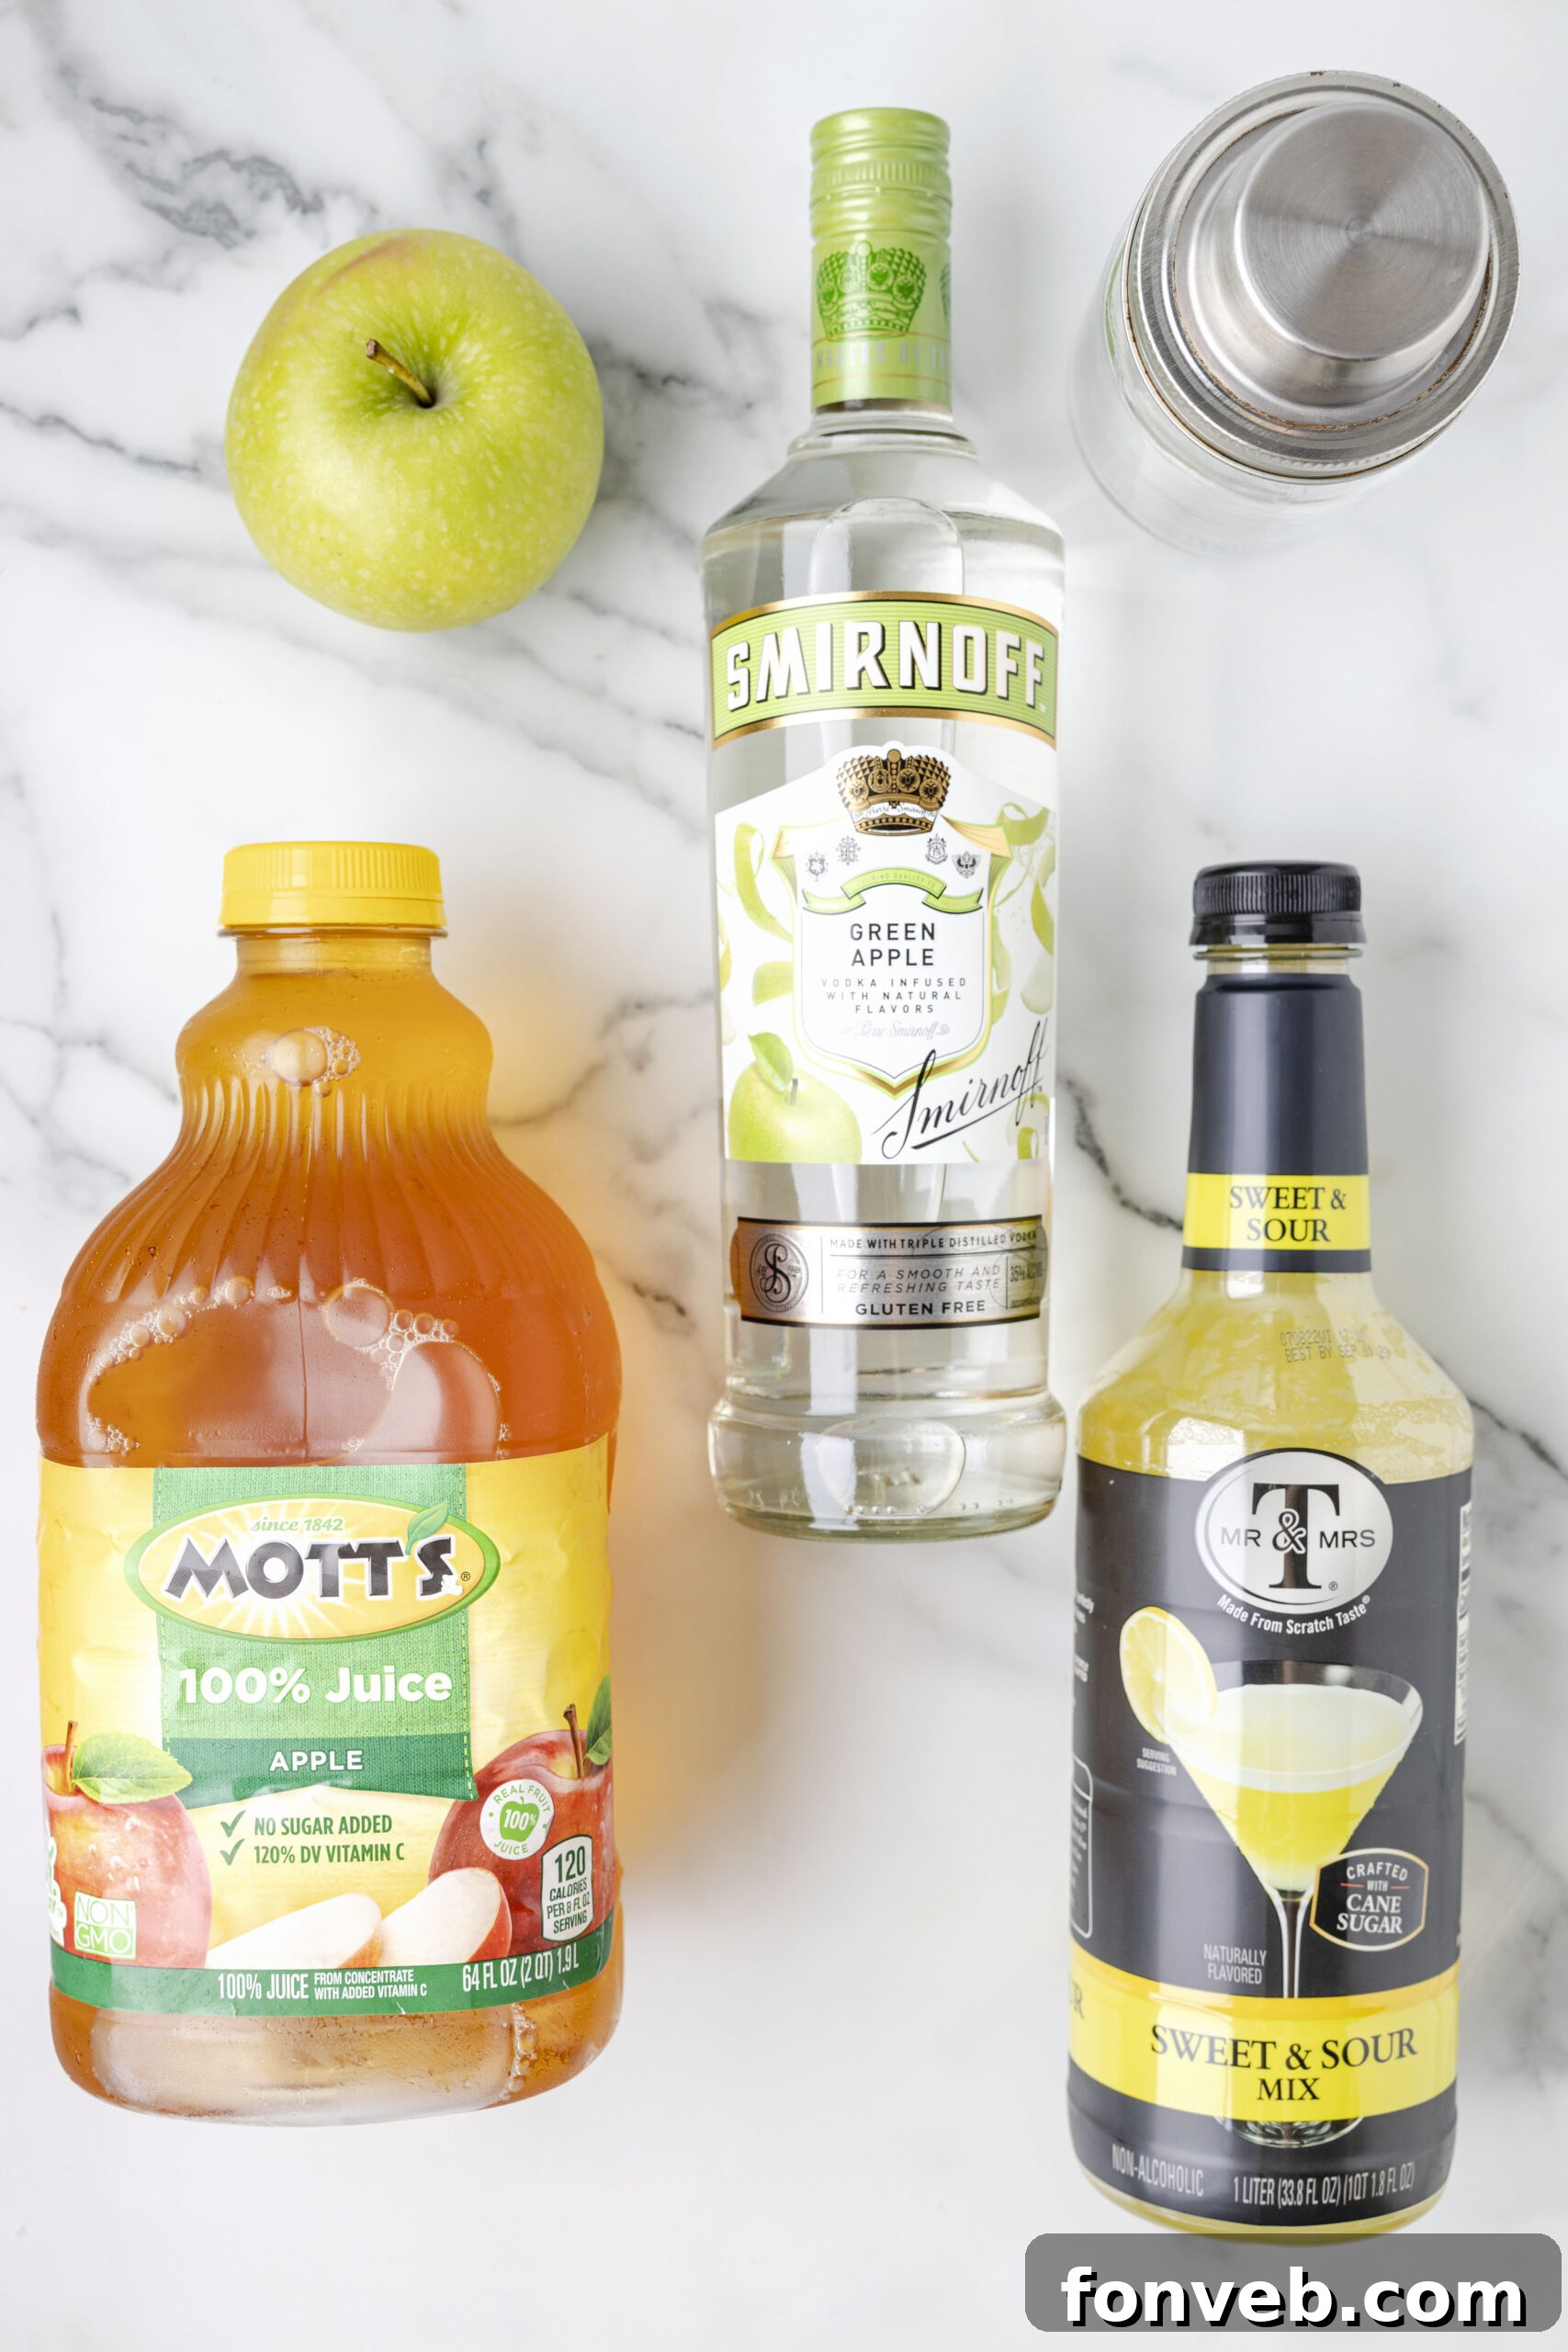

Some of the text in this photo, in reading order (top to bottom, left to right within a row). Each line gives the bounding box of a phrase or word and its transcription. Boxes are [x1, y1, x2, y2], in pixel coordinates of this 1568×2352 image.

[726, 620, 1044, 711] SMIRNOFF
[850, 922, 936, 941] GREEN
[851, 948, 934, 967] APPLE
[821, 978, 966, 987] VODKA INFUSED
[827, 991, 962, 1001] WITH NATURAL
[855, 1005, 934, 1013] FLAVORS
[871, 1017, 1049, 1159] Smirnoff
[1230, 1185, 1347, 1210] SWEET &
[1247, 1218, 1331, 1242] SOUR
[830, 1239, 863, 1249] MADE
[866, 1238, 897, 1249] WITH
[900, 1238, 944, 1249] TRIPLE
[949, 1234, 1006, 1248] DISTILLED
[837, 1265, 1000, 1280] FOR A SMOOTH AND
[837, 1278, 1000, 1294] REFRESHING TASTE
[855, 1300, 986, 1316] GLUTEN FREE
[1285, 1346, 1313, 1363] BEST
[1318, 1345, 1332, 1360] BY
[251, 1517, 344, 1532] since 1842
[1221, 1510, 1376, 1554] MR & MRS
[1252, 1483, 1340, 1589] T
[1217, 1594, 1248, 1623] Made
[1250, 1612, 1282, 1634] From
[1286, 1617, 1335, 1634] Scratch
[179, 1665, 453, 1704] 100% Juice
[269, 1750, 363, 1772] APPLE
[1142, 1747, 1170, 1763] SERVING
[1136, 1758, 1177, 1776] SUGGESTION
[493, 1784, 551, 1814] REAL FRUIT
[254, 1815, 392, 1836] NO SUGAR ADDED
[503, 1808, 537, 1831] 100%
[254, 1843, 405, 1864] 120% DV VITAMIN C
[493, 1840, 529, 1856] JUICE
[554, 1845, 586, 1883] 120
[1346, 1861, 1409, 1882] CRAFTED
[549, 1877, 588, 1902] CALORIES
[1367, 1880, 1389, 1893] WITH
[76, 1895, 130, 1927] NON
[547, 1892, 591, 1919] PER 8 FL OZ
[1346, 1894, 1402, 1914] CANE
[553, 1910, 588, 1934] SERVING
[1337, 1913, 1404, 1935] SUGAR
[75, 1922, 132, 1954] GMO
[1203, 1943, 1267, 1967] NATURALLY
[462, 1942, 580, 1993] 64 FL OZ (2 QT) 1.9 L
[1208, 1964, 1263, 1985] FLAVORED
[218, 1969, 414, 2000] 100% JUICE FROM CONCENTRATE
[314, 1983, 427, 2000] WITH ADDED VITAMIN C
[1151, 2024, 1418, 2071] SWEET & SOUR
[1257, 2077, 1321, 2101] MIX
[1111, 2143, 1205, 2198] NON-ALCOHOLIC
[1234, 2161, 1416, 2209] 1 LITER (33.8 FL OZ) (1QT 1.8 FL OZ)
